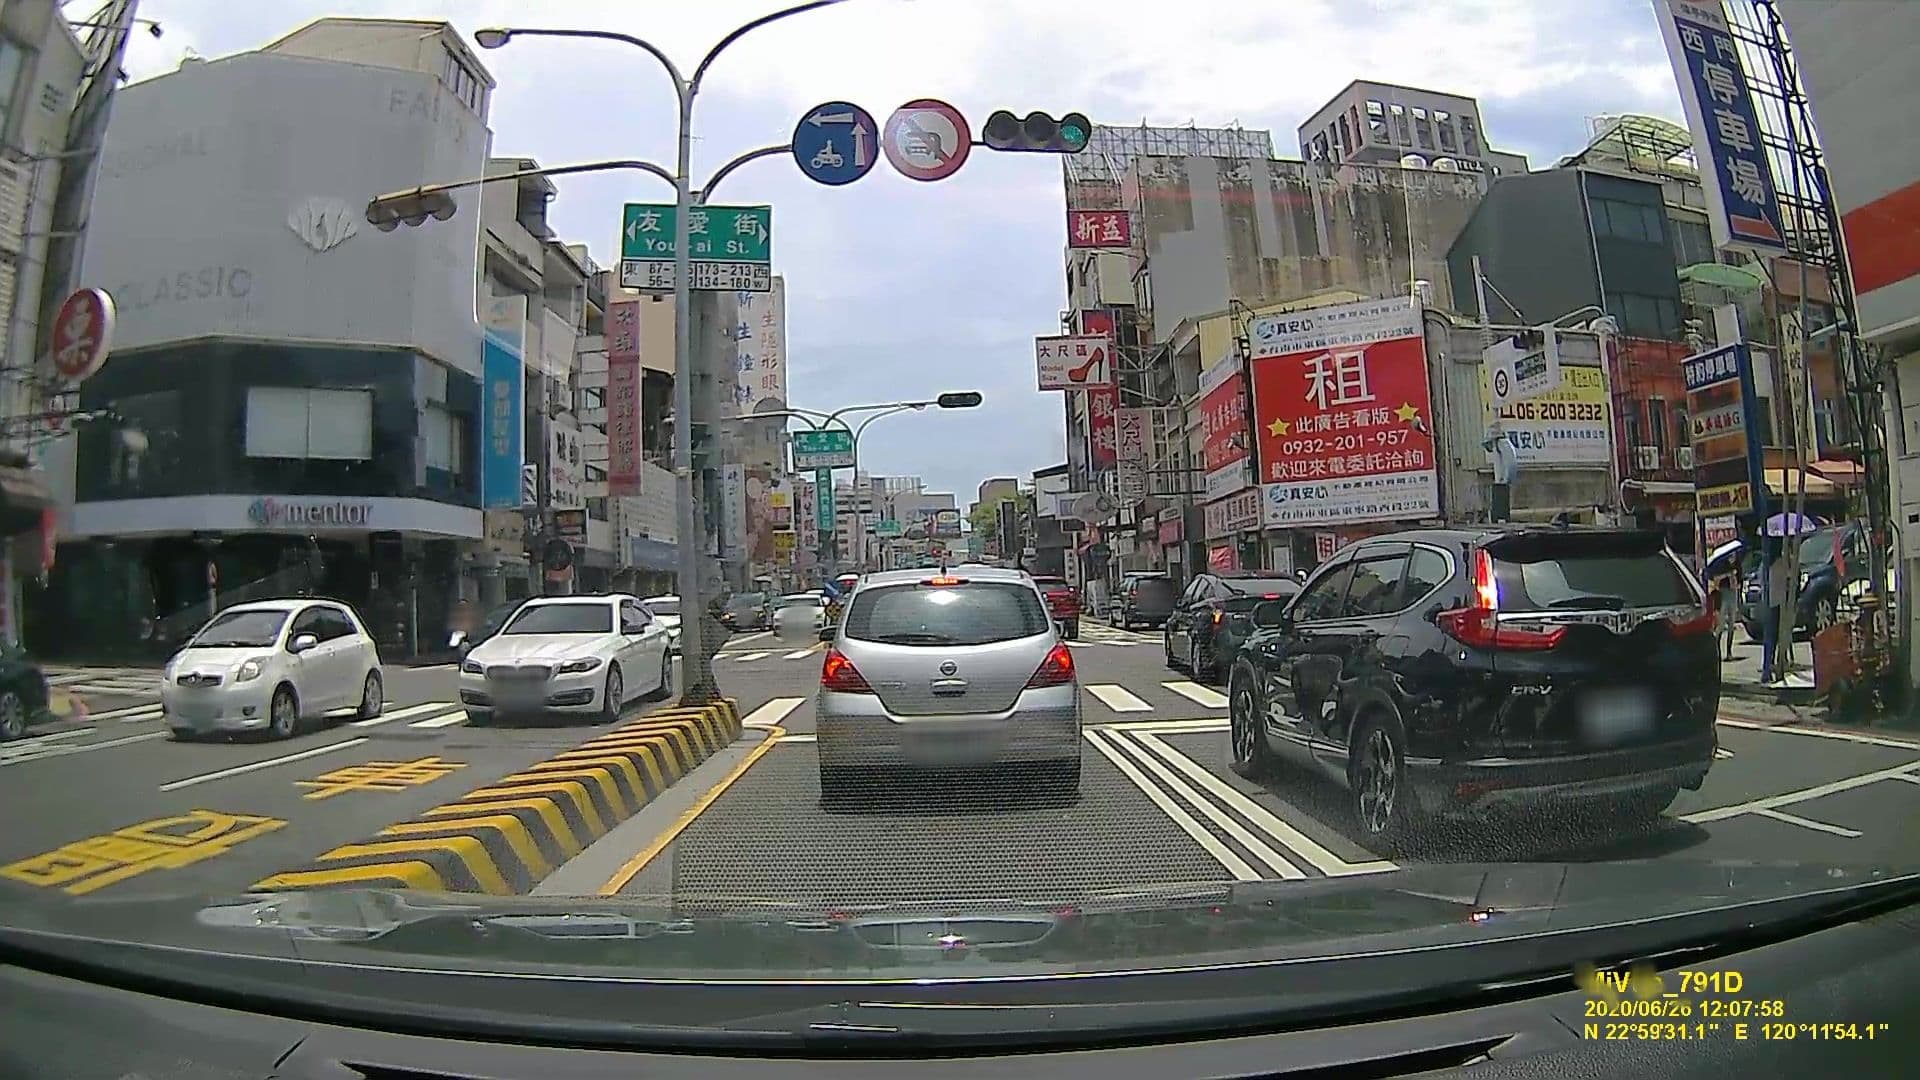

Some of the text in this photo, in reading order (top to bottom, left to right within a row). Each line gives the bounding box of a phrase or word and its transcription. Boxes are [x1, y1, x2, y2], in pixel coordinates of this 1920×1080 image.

[1702, 58, 1766, 206] 停車場
[637, 209, 759, 236] 友愛街
[1075, 213, 1124, 244] 新益
[726, 240, 750, 254] St.
[698, 263, 752, 276] 173-213
[1276, 320, 1314, 336] 真安心
[1302, 349, 1377, 411] 租
[1295, 407, 1391, 435] 此廣告看版
[1282, 429, 1409, 456] 0932-201-957
[1271, 449, 1425, 480] 歡迎來電委託洽詢
[1290, 485, 1329, 500] 真安心
[1511, 684, 1552, 695] CR-V
